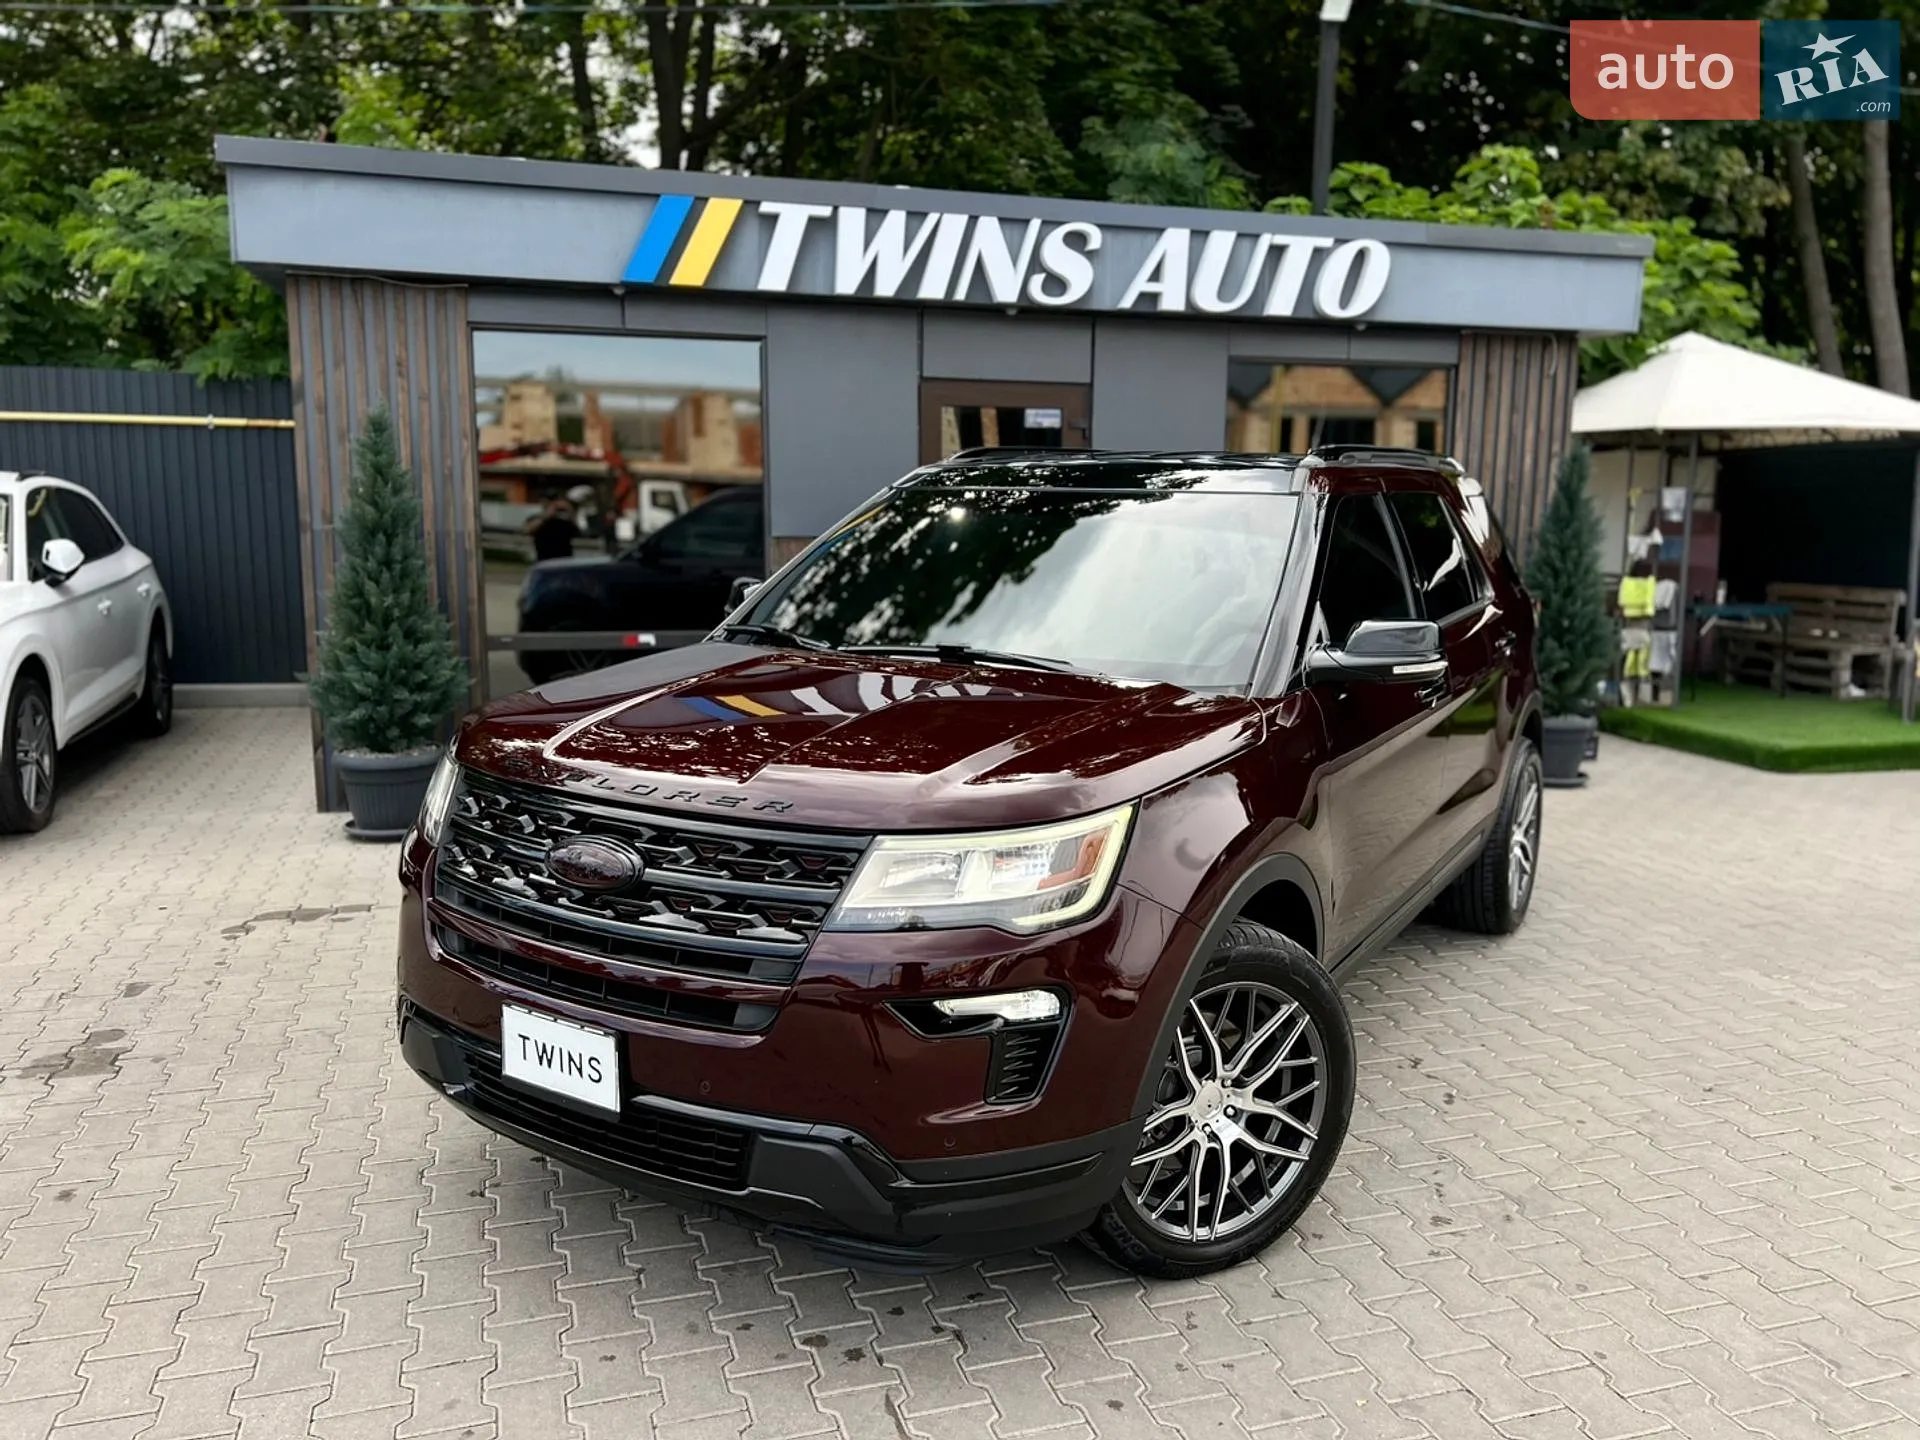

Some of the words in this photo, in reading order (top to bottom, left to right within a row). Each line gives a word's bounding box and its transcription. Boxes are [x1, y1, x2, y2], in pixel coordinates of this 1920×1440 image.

[757, 201, 1101, 306] TWINS
[1118, 227, 1391, 319] AUTO
[506, 757, 794, 813] PLORER
[518, 1033, 603, 1084] TWINS
